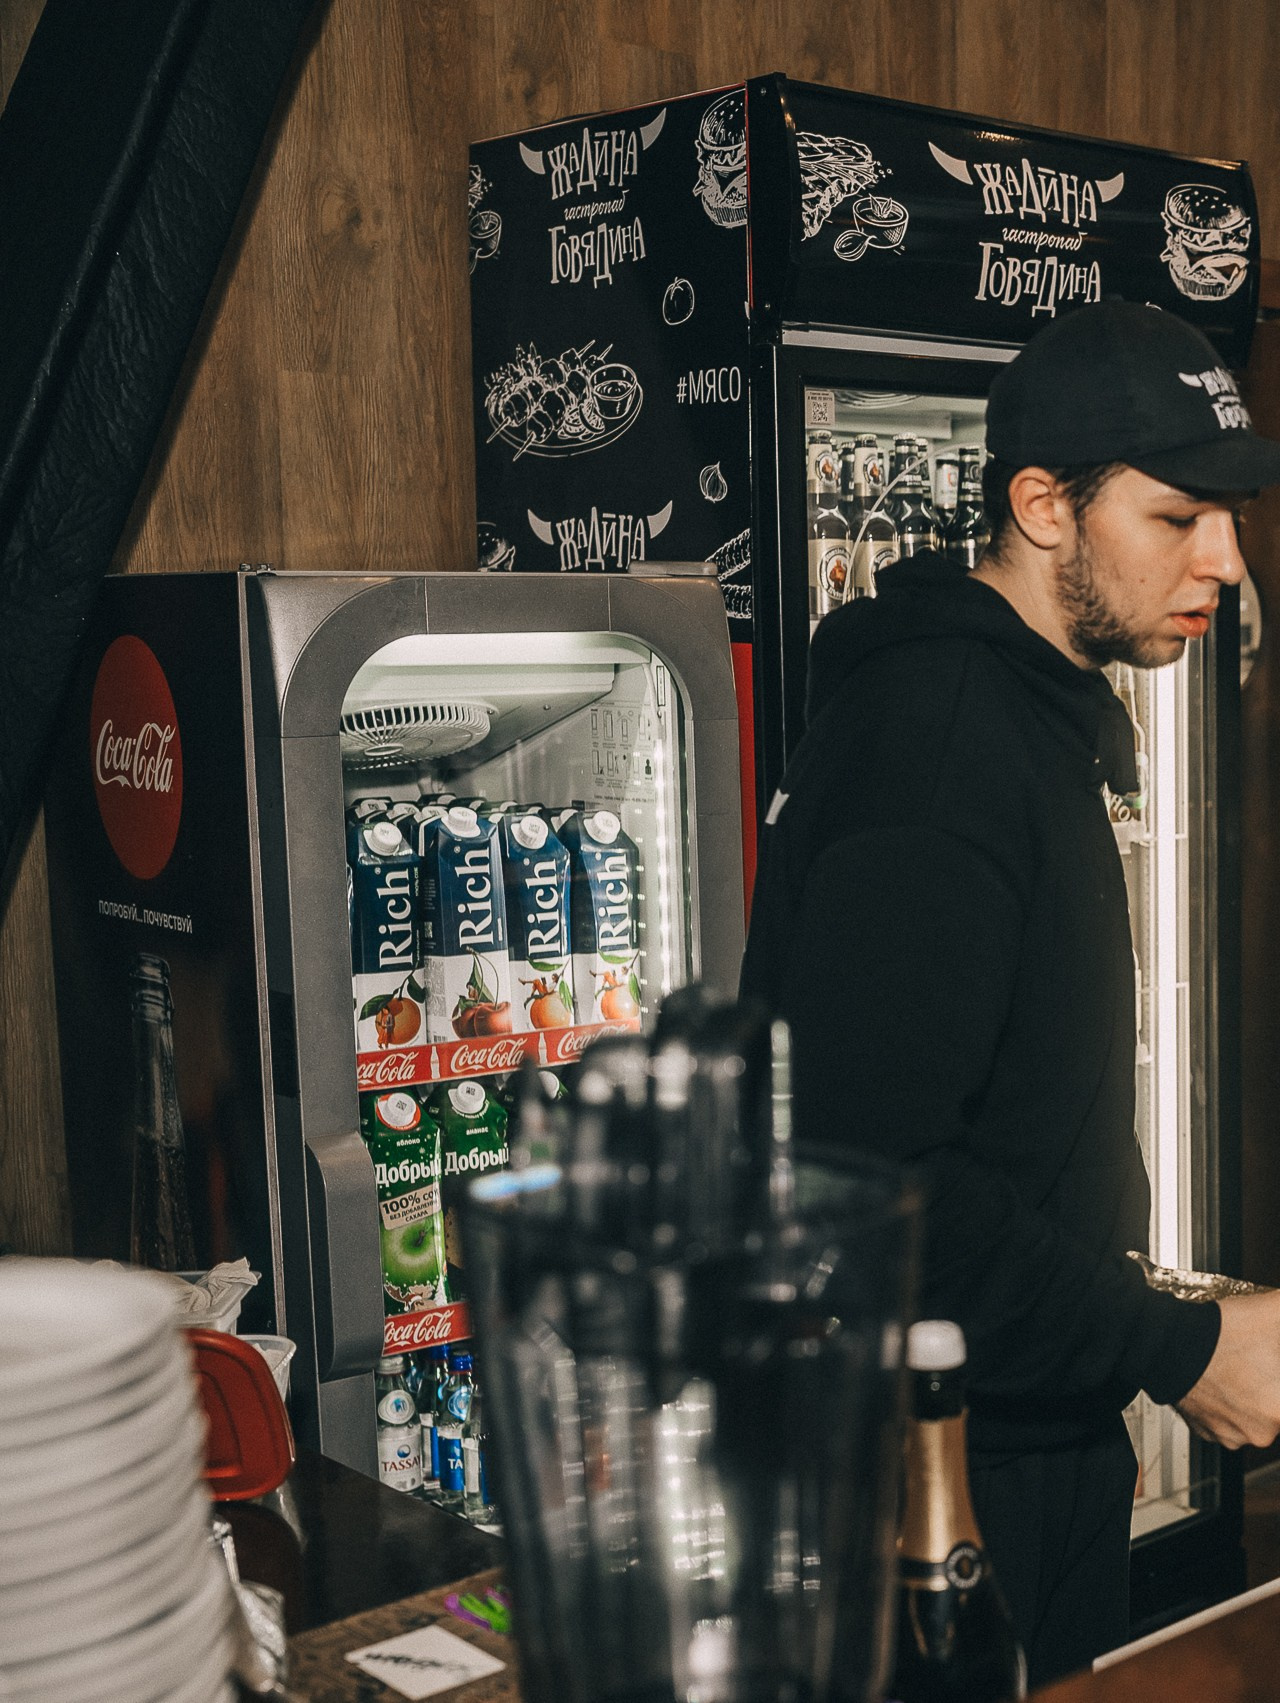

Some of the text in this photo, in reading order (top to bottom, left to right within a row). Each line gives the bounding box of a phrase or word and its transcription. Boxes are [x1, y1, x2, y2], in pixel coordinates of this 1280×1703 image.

[676, 366, 741, 405] #МЯСО
[96, 719, 176, 793] Coca-Cola
[376, 867, 413, 969] Rich
[454, 846, 494, 948] Rich
[525, 858, 561, 957] Rich
[596, 854, 631, 954] Rich
[357, 1051, 419, 1085] ca-Cola
[450, 1037, 527, 1073] Coca-Cola
[444, 1142, 509, 1176] Добрый
[382, 1192, 421, 1215] 100%
